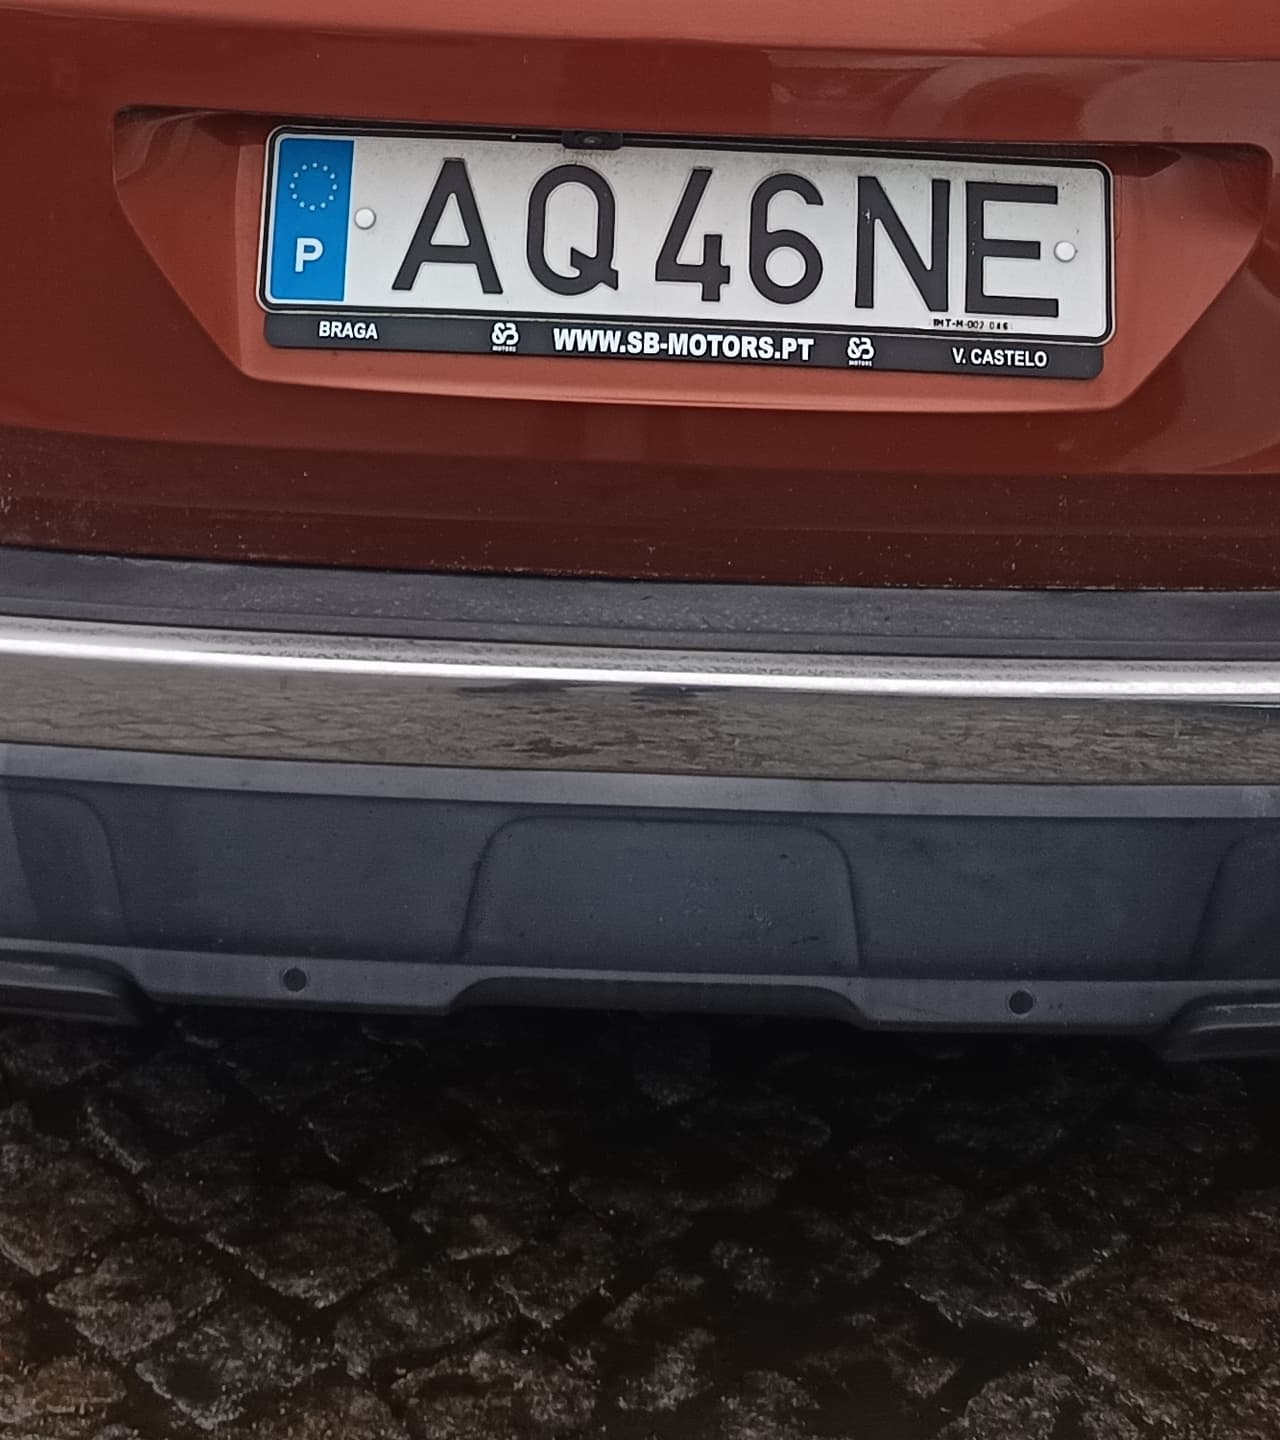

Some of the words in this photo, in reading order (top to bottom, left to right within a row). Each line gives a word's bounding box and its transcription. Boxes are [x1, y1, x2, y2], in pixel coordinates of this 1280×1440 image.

[295, 237, 324, 273] P
[318, 321, 379, 340] BRAGA
[552, 327, 815, 361] WWW.SB-MOTORS.PT
[952, 347, 966, 364] V.
[970, 348, 1048, 368] CASTELO
